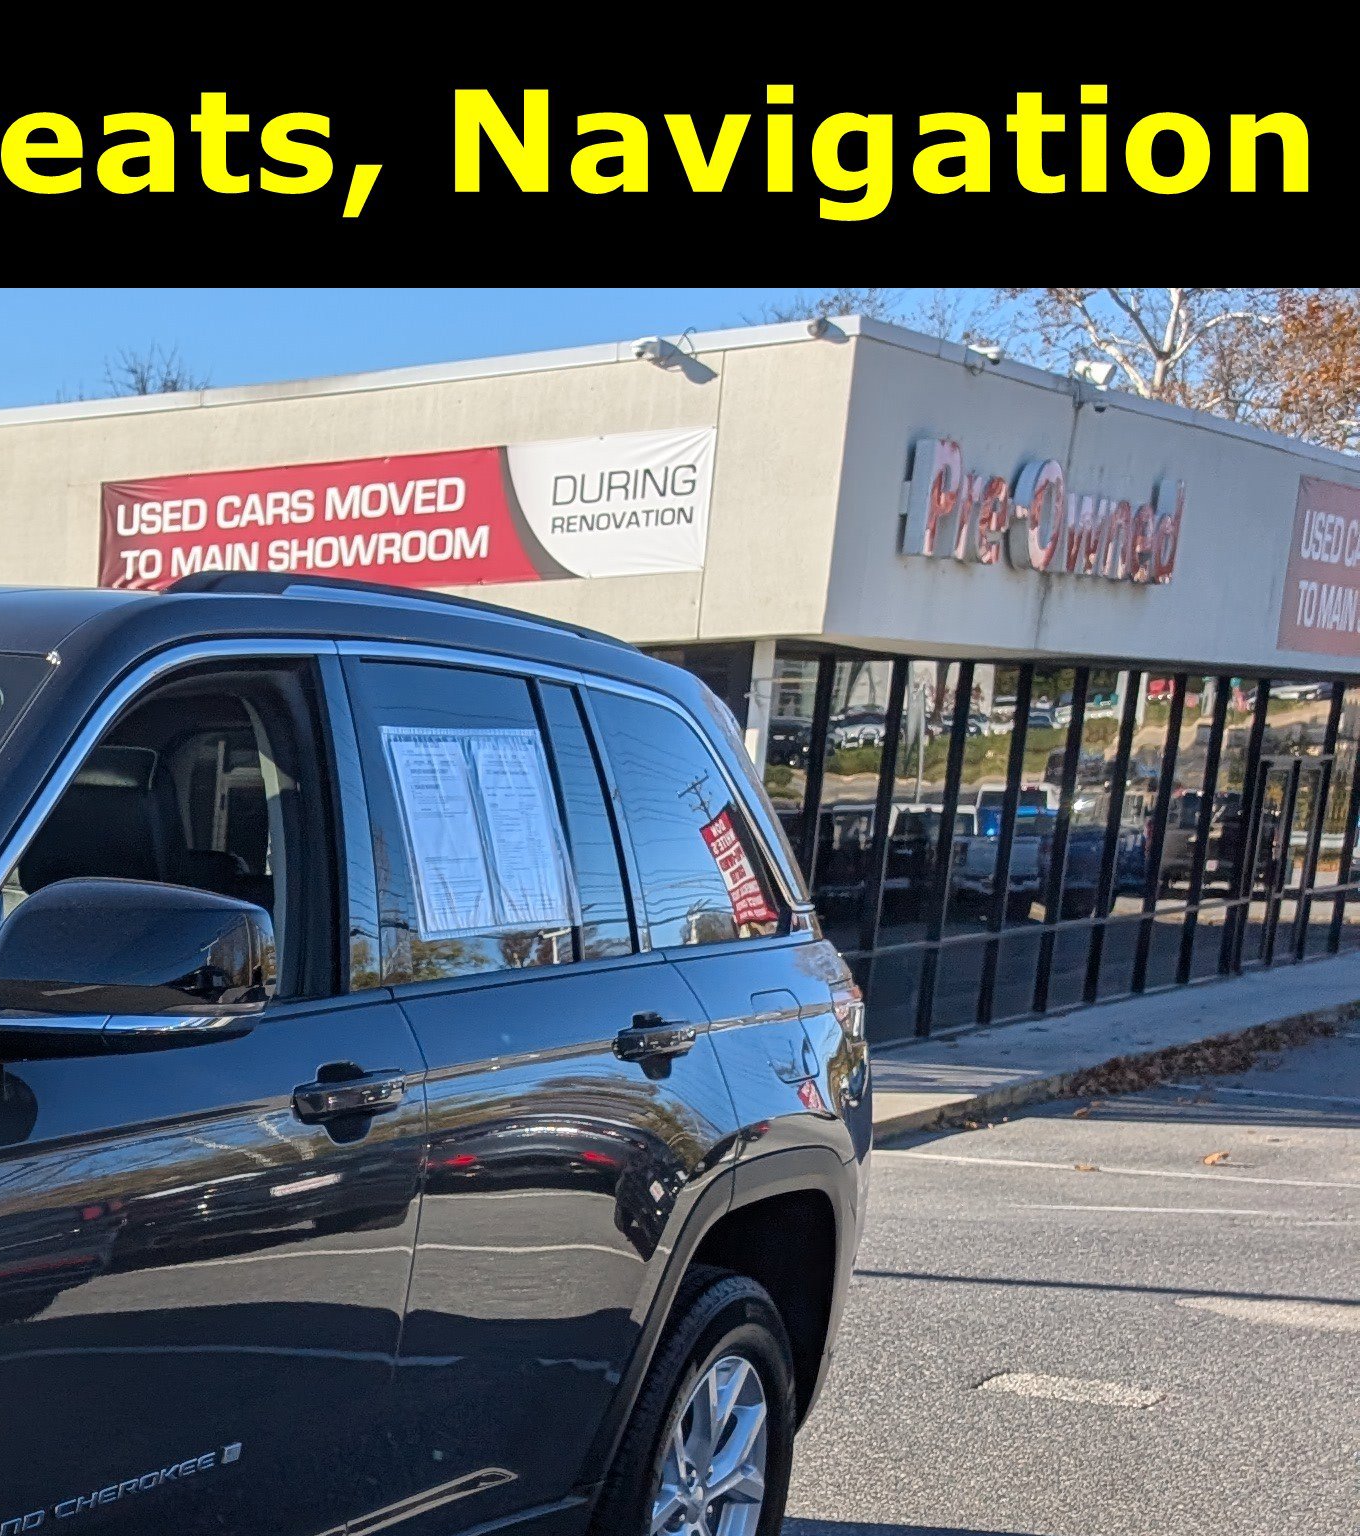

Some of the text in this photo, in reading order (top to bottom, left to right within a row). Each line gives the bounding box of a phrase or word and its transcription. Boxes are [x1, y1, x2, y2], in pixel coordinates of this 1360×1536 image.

[116, 476, 467, 537] USED CARS MOVED
[552, 463, 697, 506] DURING
[918, 435, 1186, 585] Pre-Owned
[550, 506, 694, 534] RENOVATION
[1301, 509, 1345, 564] USED
[119, 525, 491, 581] TO MAIN SHOWROOM
[1296, 579, 1359, 633] TO MAIN
[54, 1451, 216, 1518] CHEROKEE
